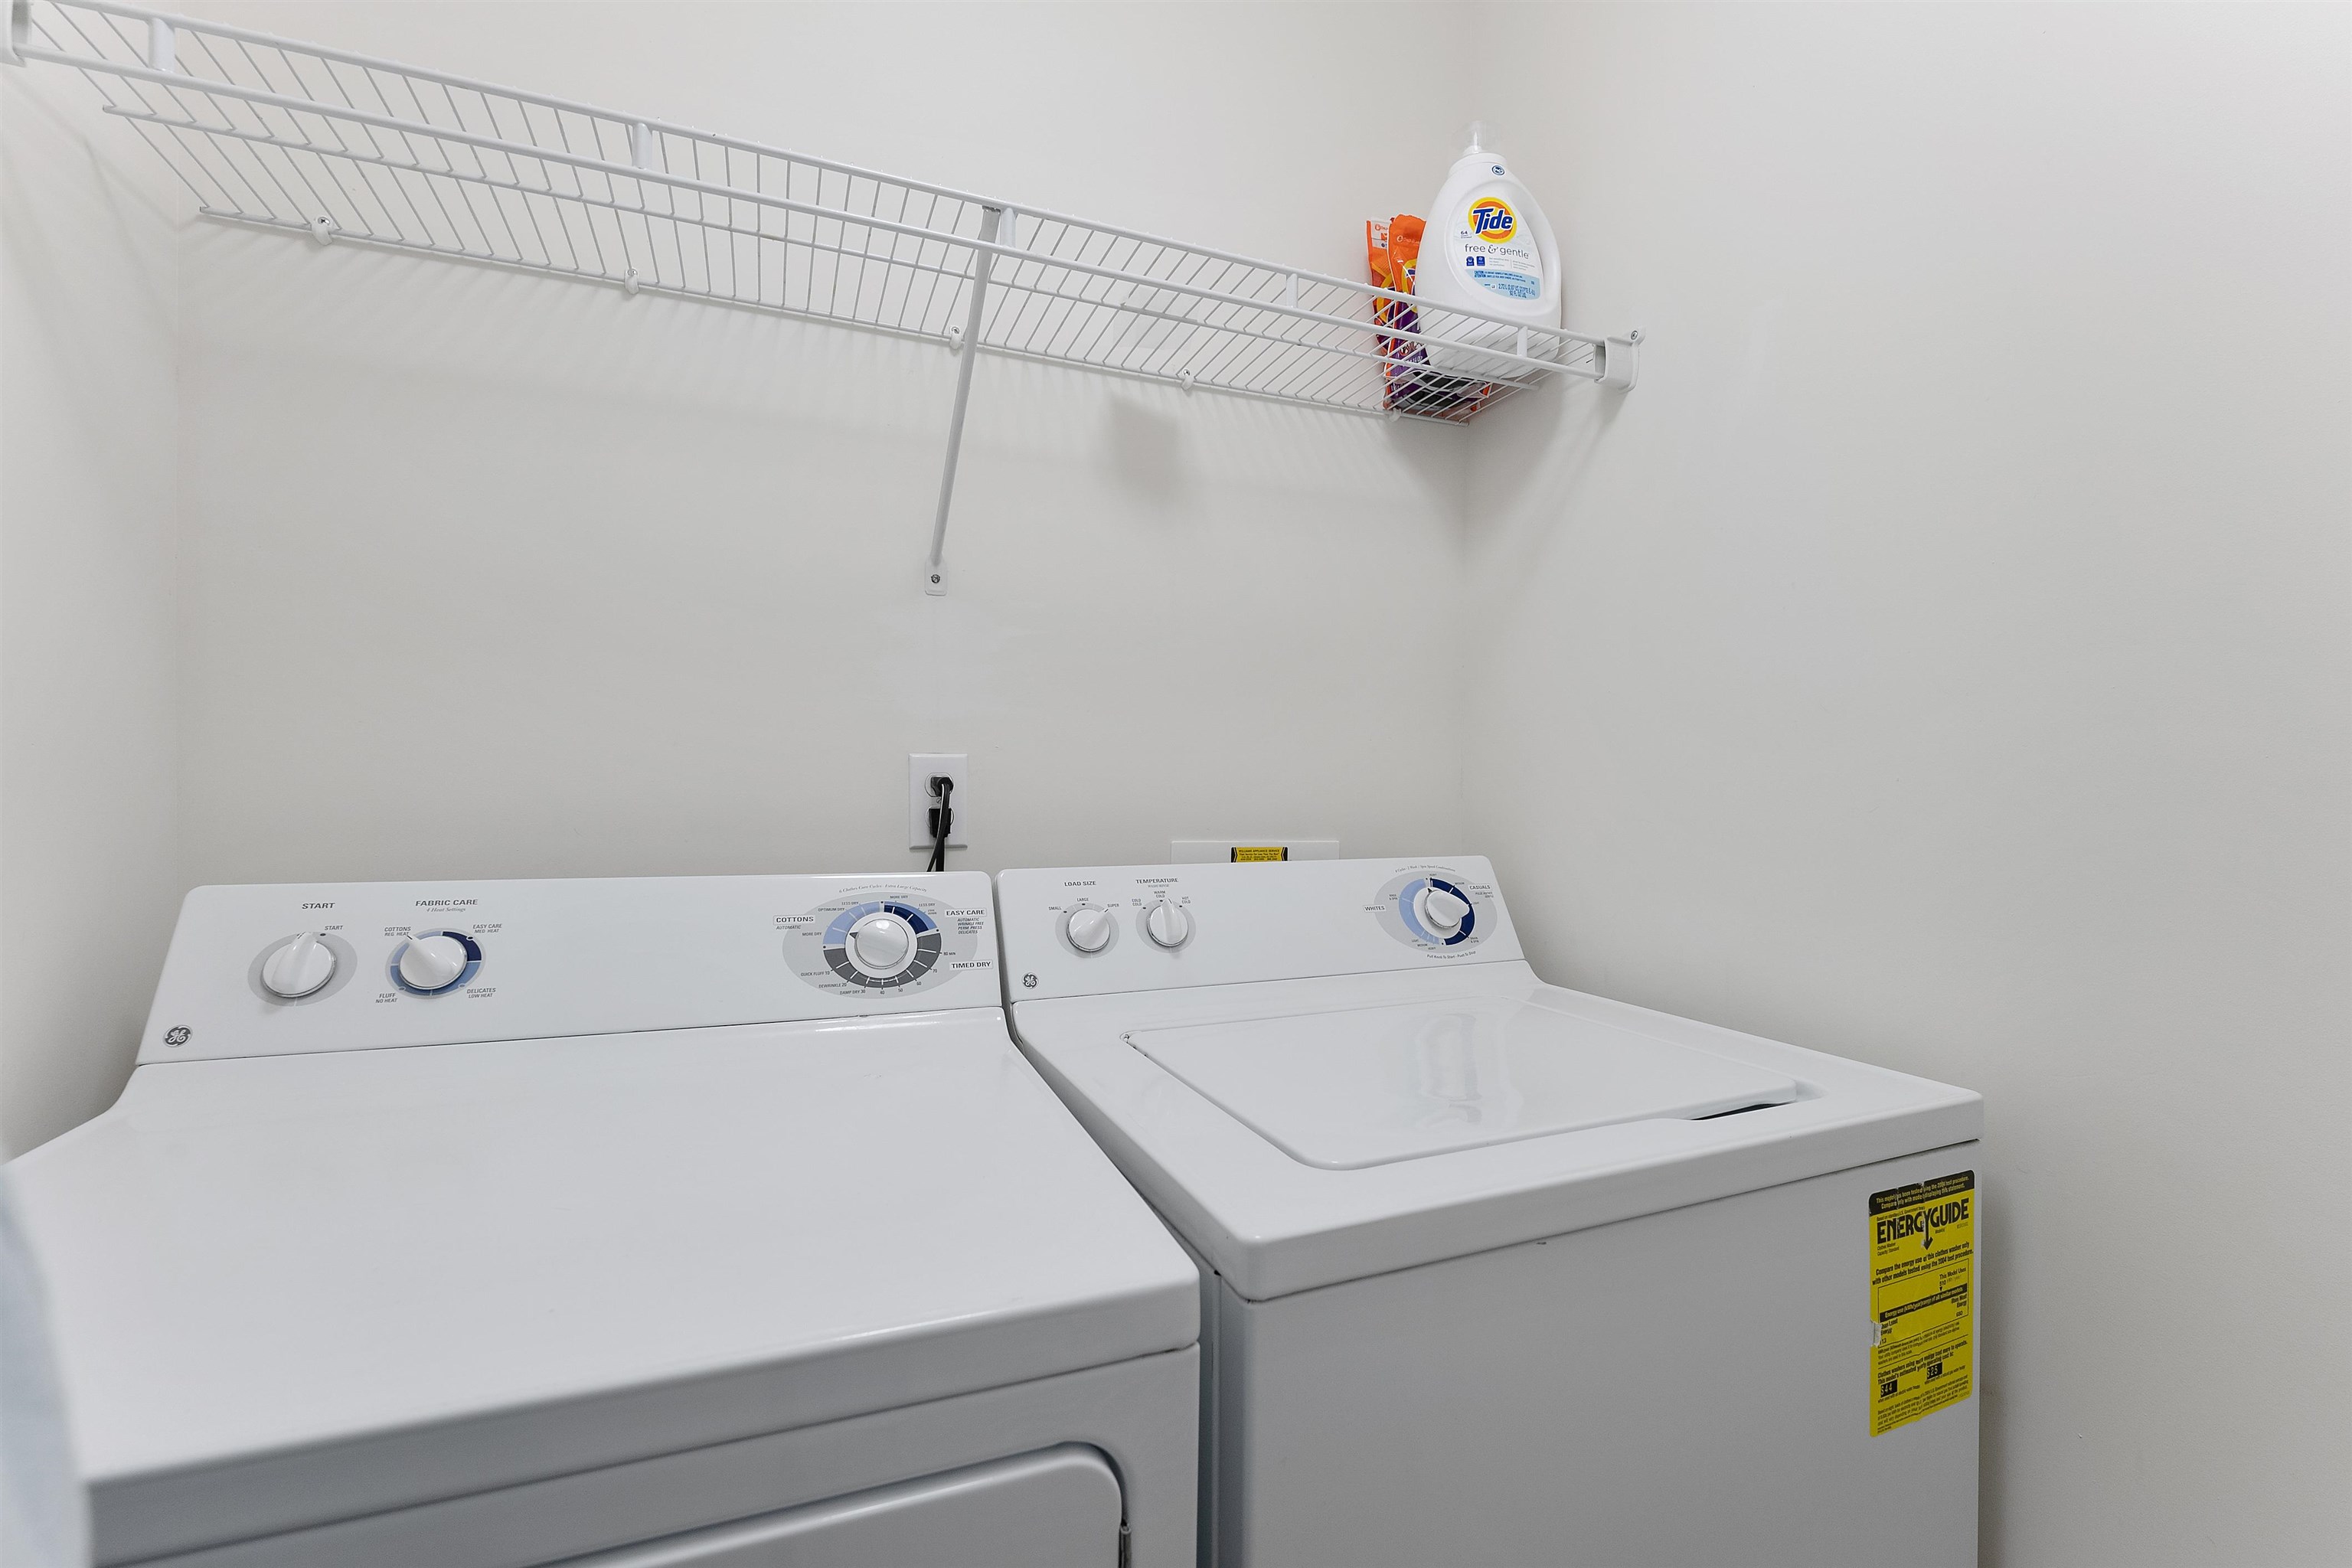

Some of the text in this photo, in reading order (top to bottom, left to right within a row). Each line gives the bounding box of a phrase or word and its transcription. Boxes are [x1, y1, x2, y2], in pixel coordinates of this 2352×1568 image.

[1473, 207, 1513, 234] Tide
[1465, 243, 1529, 259] free & gentle
[1877, 1197, 1969, 1245] ENERGYGUIDE
